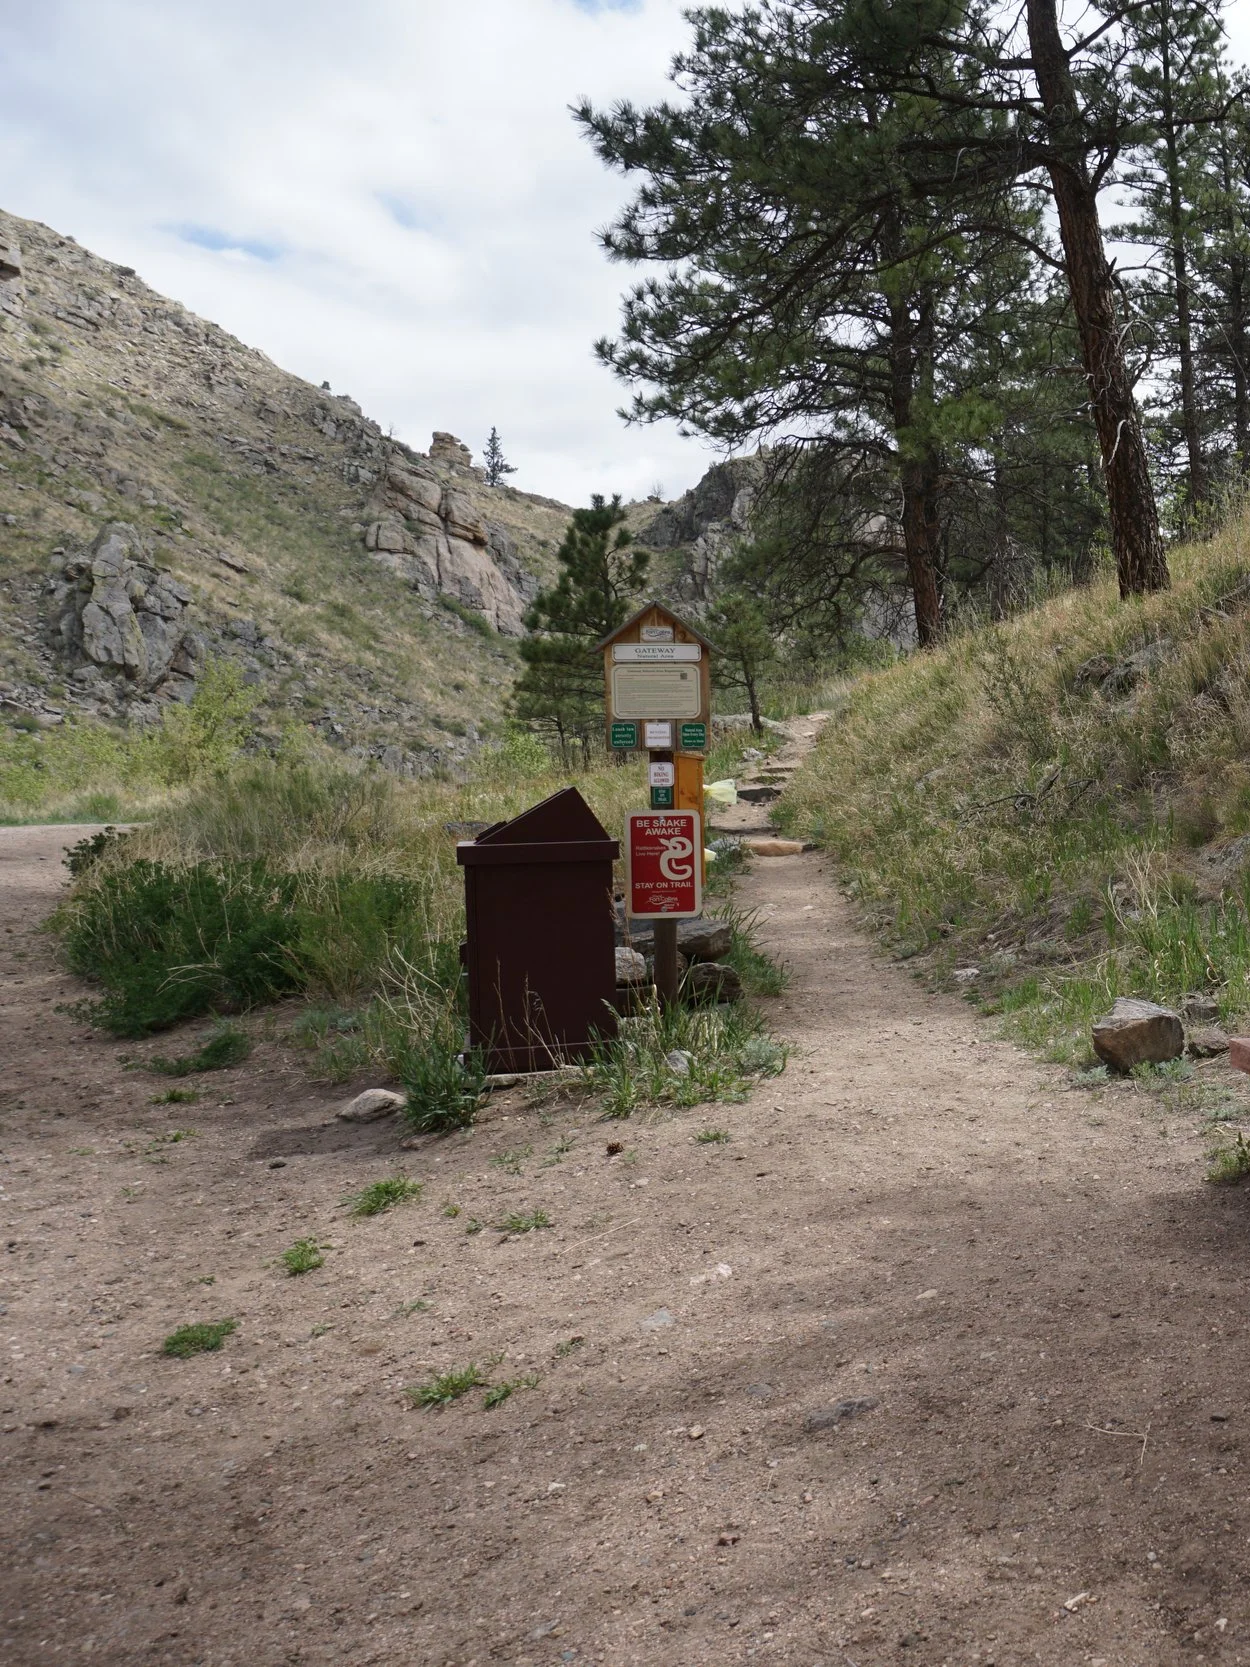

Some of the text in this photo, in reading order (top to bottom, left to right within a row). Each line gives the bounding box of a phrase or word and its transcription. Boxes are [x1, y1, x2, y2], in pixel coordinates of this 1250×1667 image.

[636, 819, 687, 828] BE SNAKE
[645, 827, 682, 835] AWAKE
